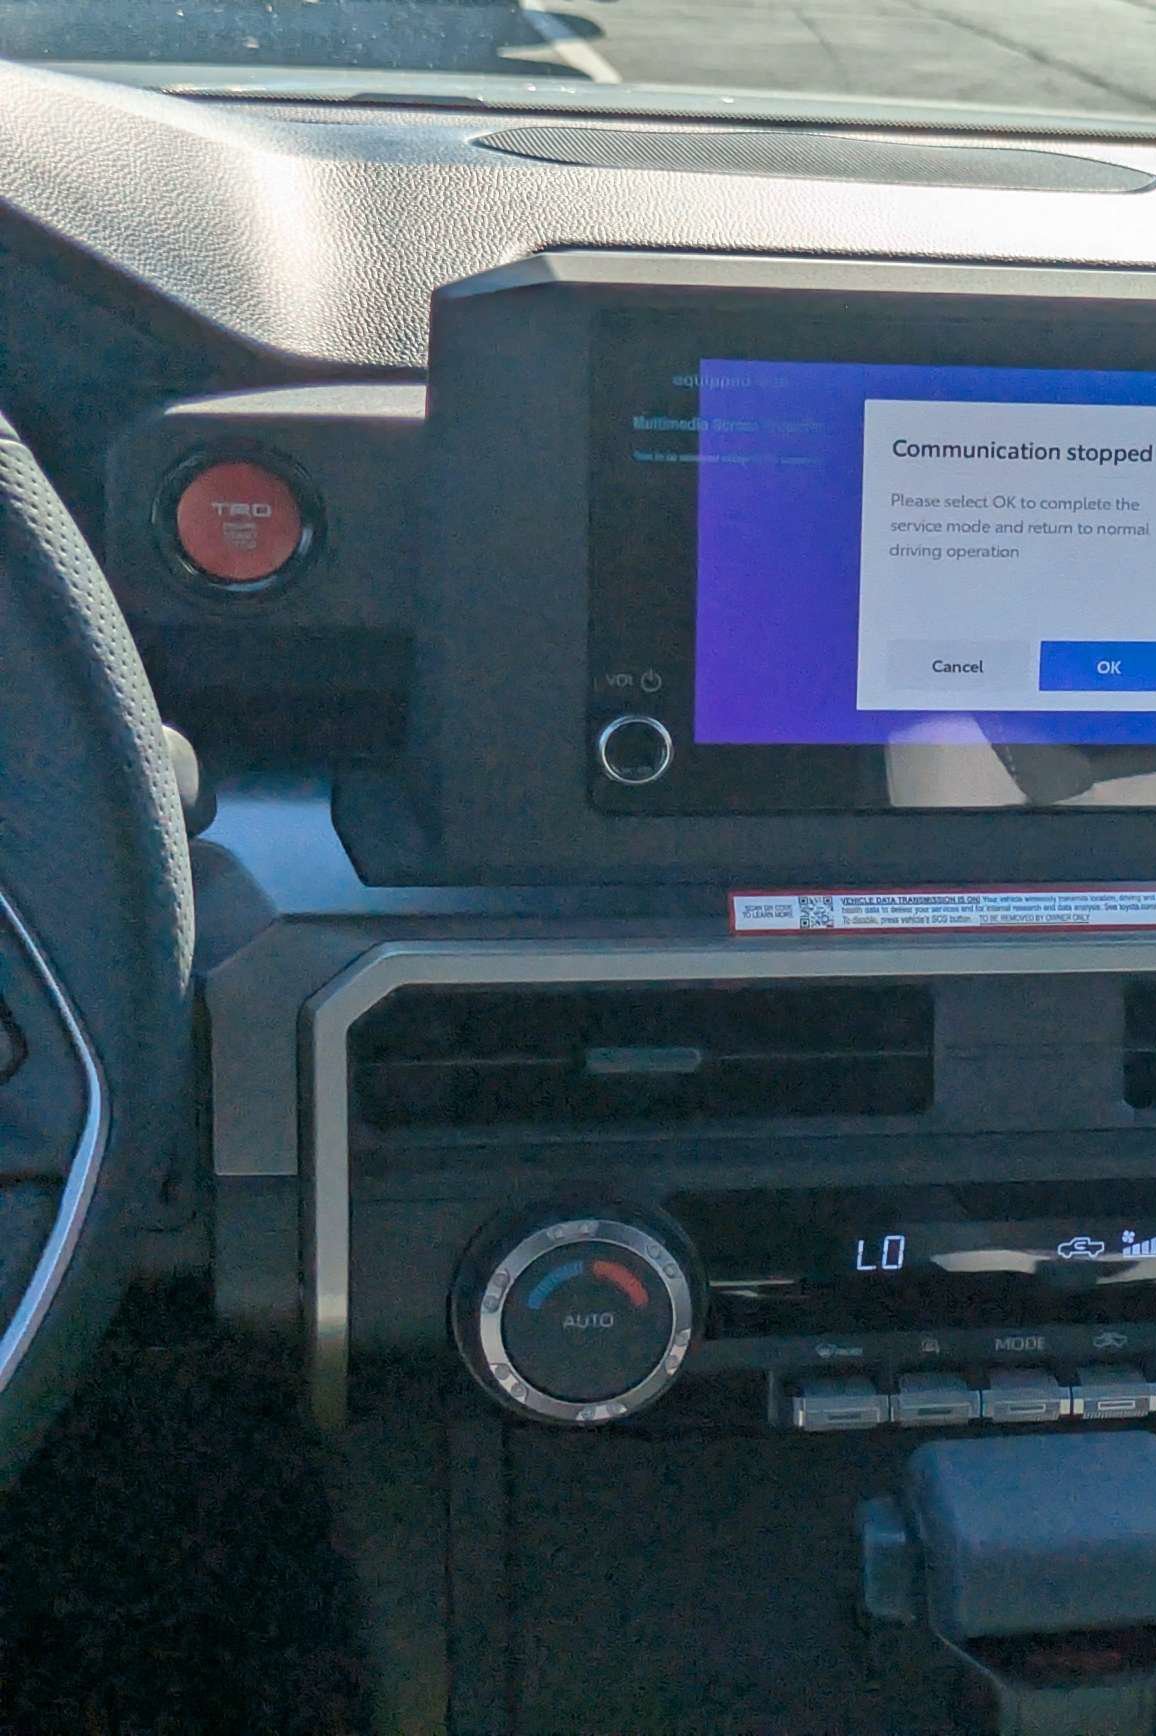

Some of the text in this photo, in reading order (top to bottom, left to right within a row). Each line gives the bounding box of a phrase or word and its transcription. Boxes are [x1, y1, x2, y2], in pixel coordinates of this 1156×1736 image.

[892, 440, 1153, 465] Communication stopped
[211, 502, 272, 518] TRD
[891, 494, 1140, 513] Please select OK to complete the
[891, 519, 1150, 536] service mode and return to normal
[889, 544, 1020, 560] driving operation
[932, 659, 1122, 675] Cancel OK
[606, 674, 634, 687] VOL
[563, 1313, 614, 1329] AUTO
[995, 1337, 1045, 1352] MODE
